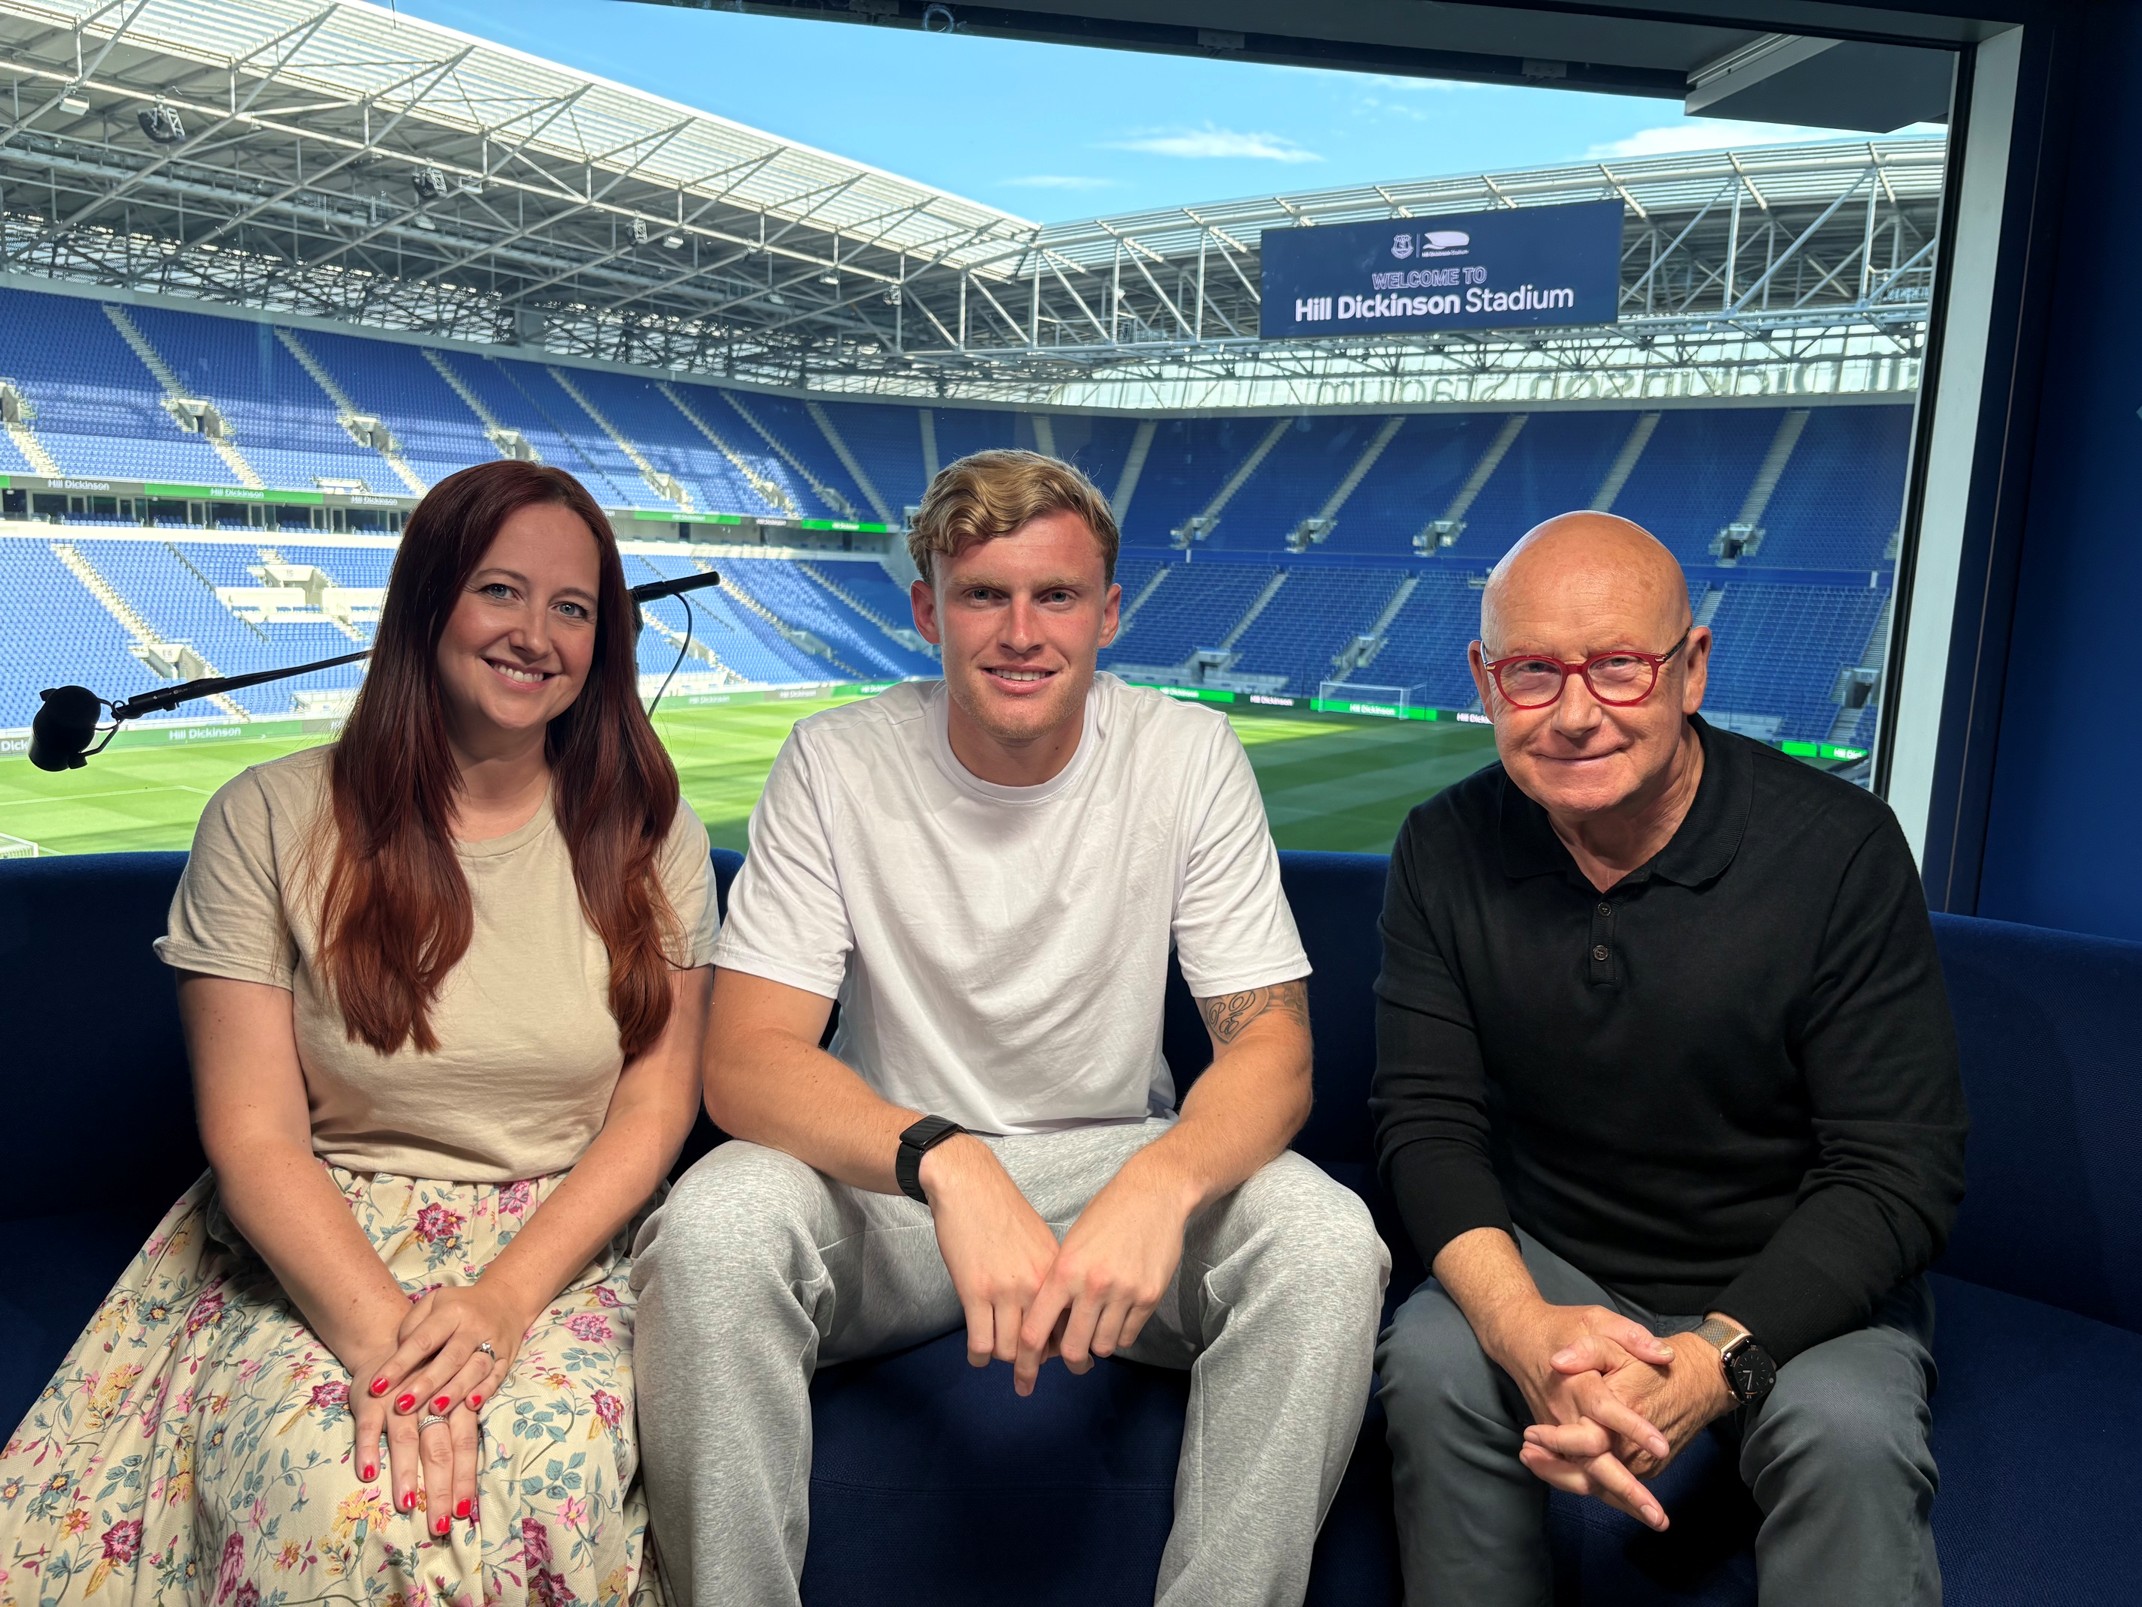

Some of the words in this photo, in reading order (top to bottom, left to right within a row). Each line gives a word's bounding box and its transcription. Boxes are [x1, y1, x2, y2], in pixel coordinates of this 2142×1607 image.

[1372, 268, 1460, 290] WELCOME
[1462, 266, 1487, 285] TO
[1295, 297, 1332, 322] Hill
[1338, 292, 1461, 320] Dickinson
[1465, 284, 1574, 313] Stadium
[48, 479, 63, 488] Hill
[65, 480, 110, 491] Dickinson
[168, 730, 186, 740] Hill
[188, 727, 241, 739] Dickinson
